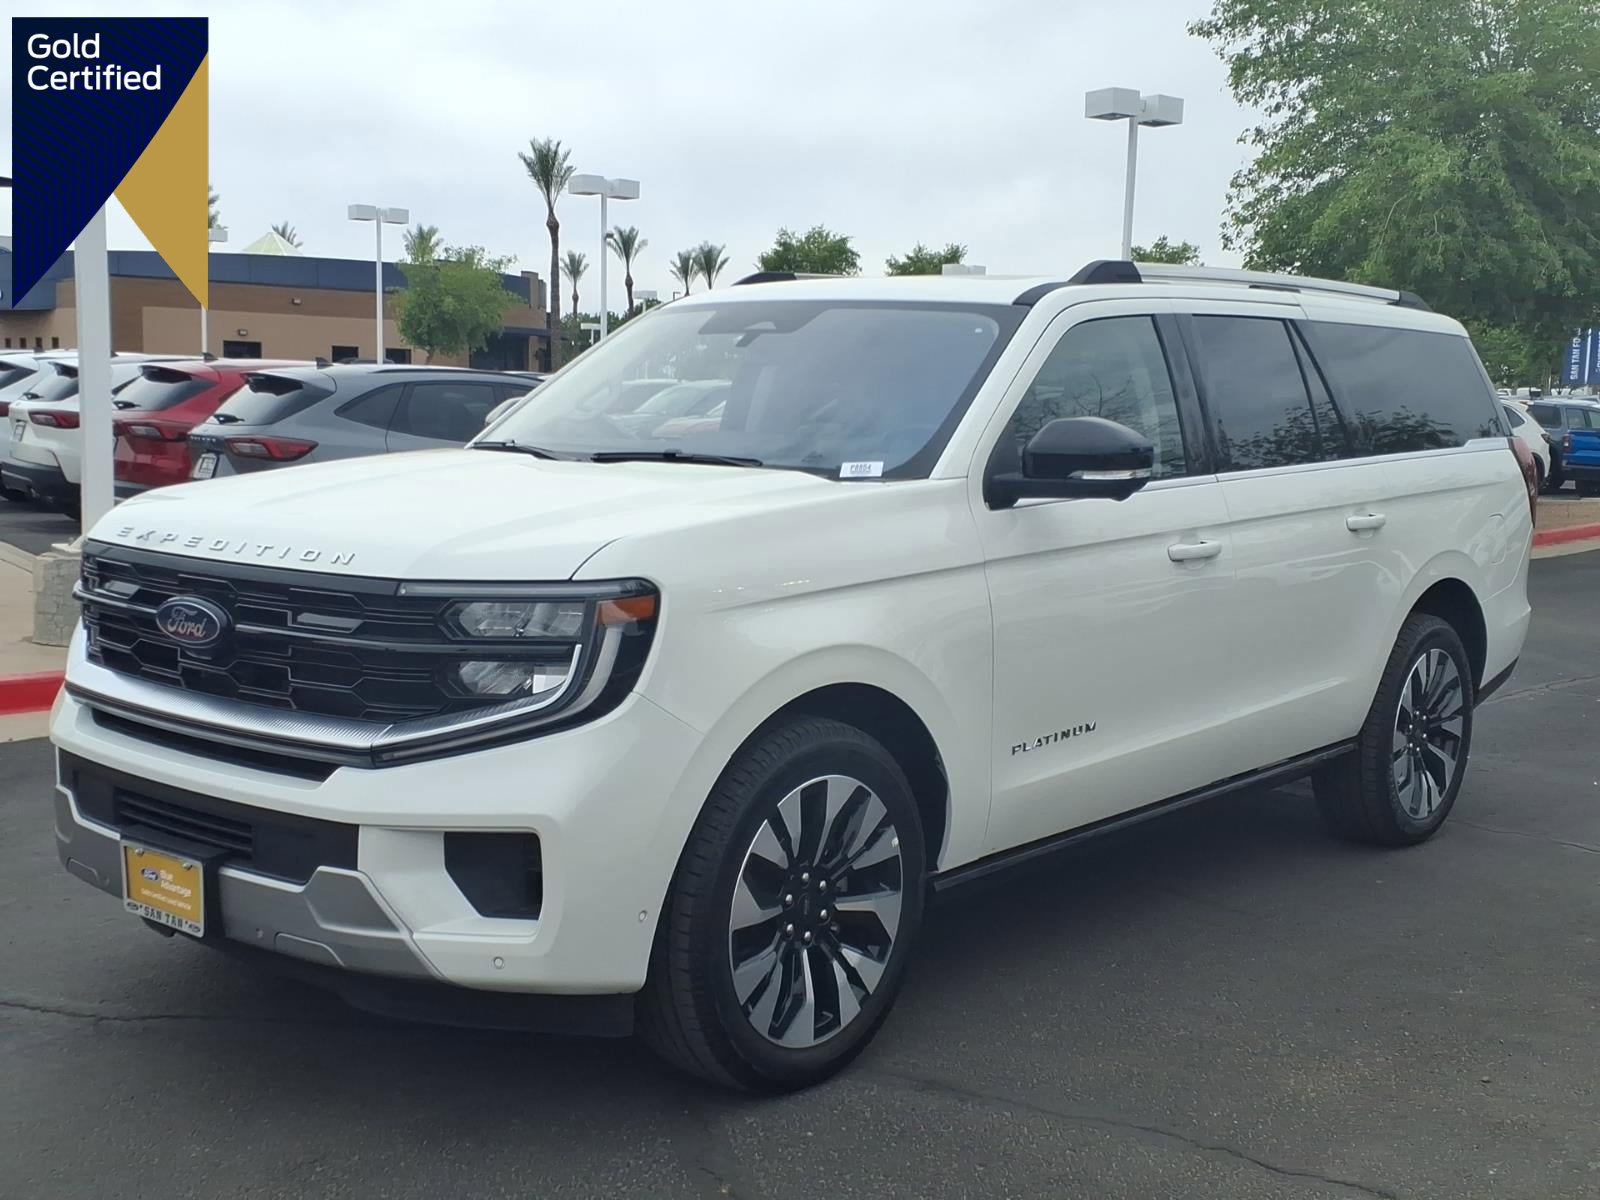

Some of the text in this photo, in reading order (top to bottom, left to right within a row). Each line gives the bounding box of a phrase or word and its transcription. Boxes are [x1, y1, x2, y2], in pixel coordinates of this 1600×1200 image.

[117, 526, 355, 565] EXPEDITION
[167, 606, 208, 639] Ford
[1011, 720, 1098, 756] PLATINUM
[144, 906, 162, 921] SAN
